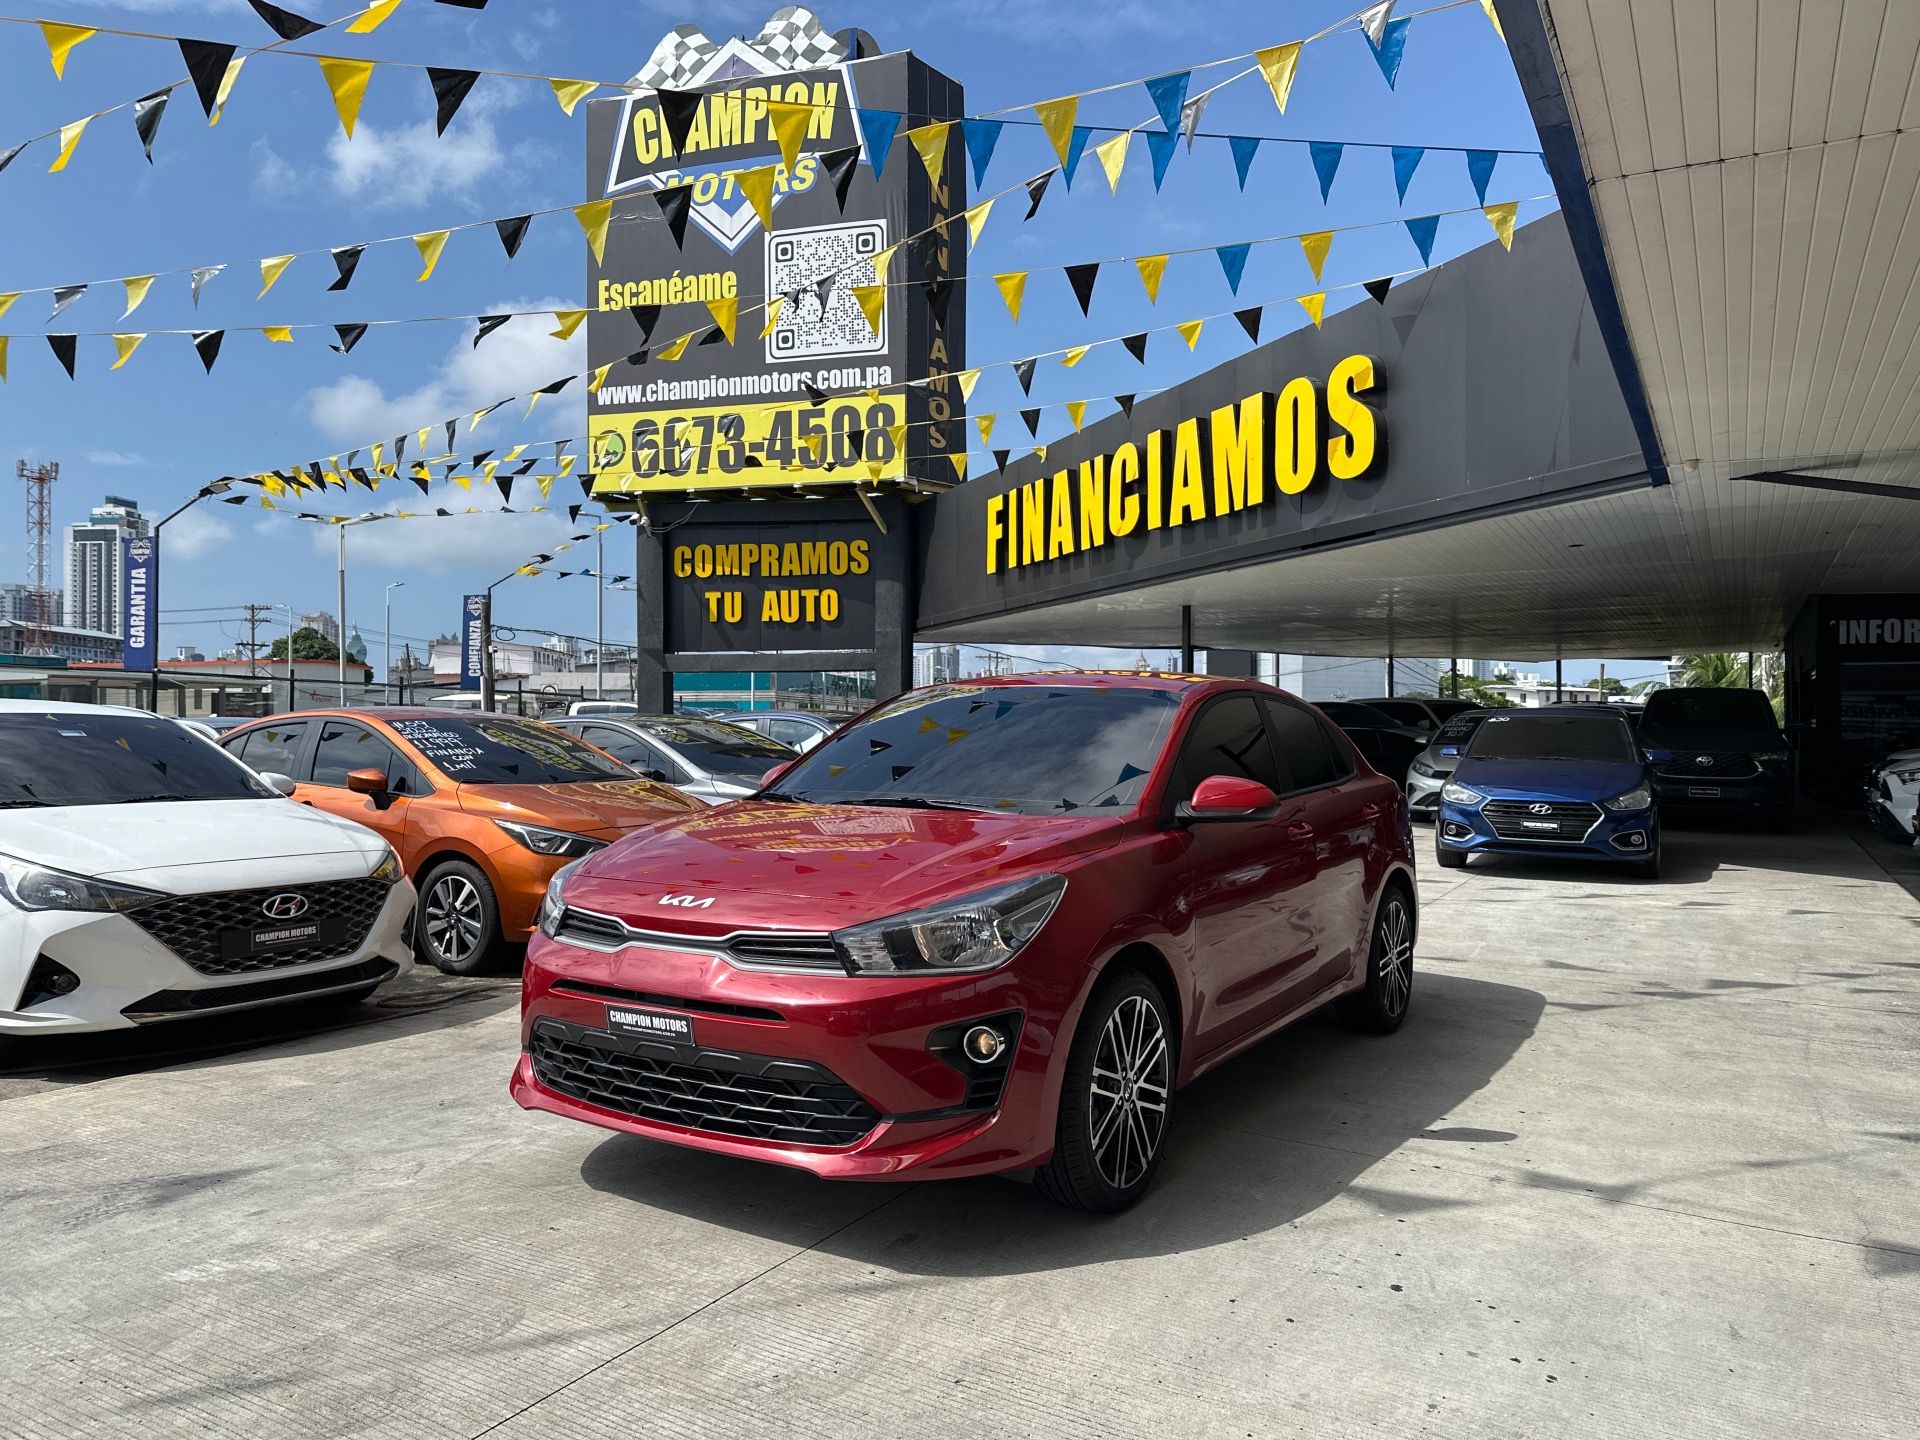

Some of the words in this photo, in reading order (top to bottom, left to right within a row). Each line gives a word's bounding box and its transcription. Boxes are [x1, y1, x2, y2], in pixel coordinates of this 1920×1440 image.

[664, 158, 817, 204] OTRS
[598, 270, 737, 312] Escanéame
[597, 365, 892, 405] www.championmotors.com.pa
[632, 403, 895, 478] 6673-4508
[986, 354, 1376, 574] FINANCIAMOS
[674, 540, 870, 577] COMPRAMOS
[130, 567, 147, 648] GARANTIA
[705, 591, 742, 623] TU
[761, 588, 839, 623] AUTO
[468, 620, 482, 677] CONFIANZA
[425, 747, 485, 758] FINANCIA
[256, 931, 290, 942] CHAMPION
[290, 926, 317, 936] MOTORS
[609, 1010, 652, 1028] CHAMPION
[651, 1016, 688, 1033] MOTORS
